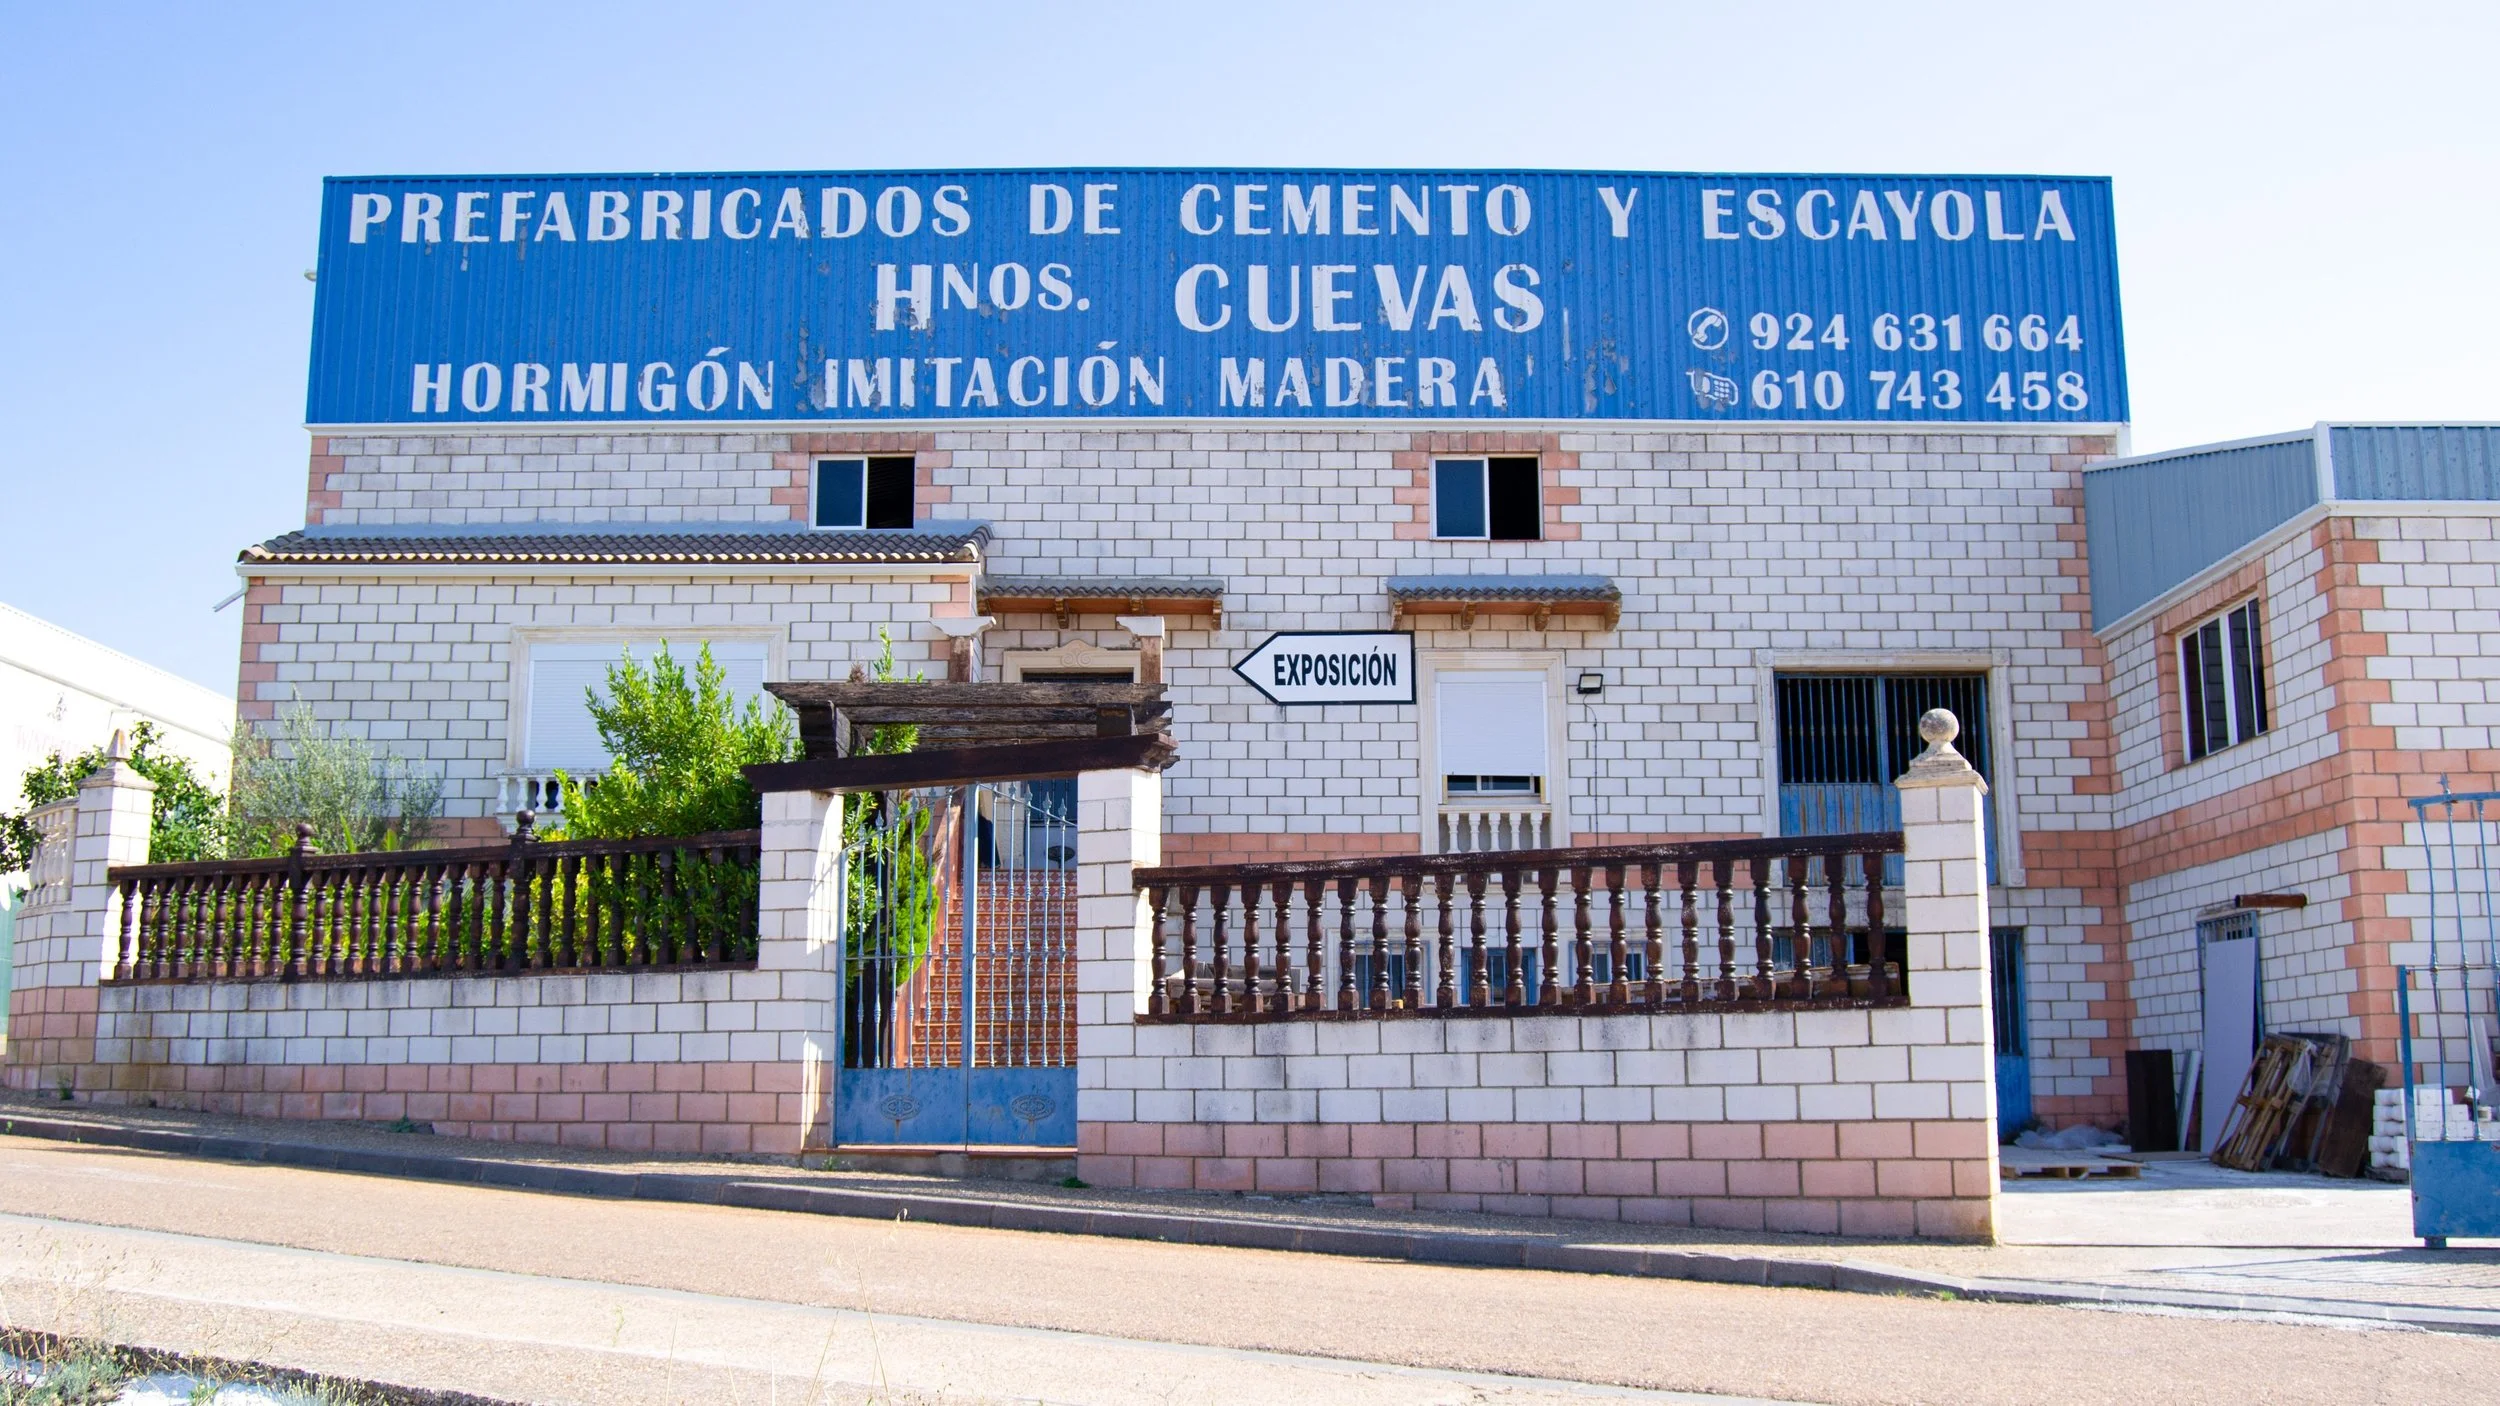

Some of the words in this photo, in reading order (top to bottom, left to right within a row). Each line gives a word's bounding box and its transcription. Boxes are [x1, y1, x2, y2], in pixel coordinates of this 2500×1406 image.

[351, 185, 970, 243] PREFABRICADOS
[1030, 183, 1121, 235] DE
[1180, 183, 1531, 236] CEMENTO
[1597, 187, 1638, 237] Y
[1703, 189, 2076, 241] ESCAYOLA
[876, 262, 1090, 330] HNOS.
[1175, 263, 1544, 332] CUEVAS
[1750, 312, 1849, 350] 924
[1873, 313, 1962, 351] 631
[1983, 314, 2083, 351] 664
[411, 346, 774, 413] HORMIGÓN
[824, 341, 1164, 408] IMITACIÓN
[1219, 357, 1507, 407] MADERA
[1752, 370, 1845, 410] 610
[1870, 370, 1962, 410] 743
[1986, 371, 2088, 411] 458
[1273, 645, 1397, 686] EXPOSICIÓN
